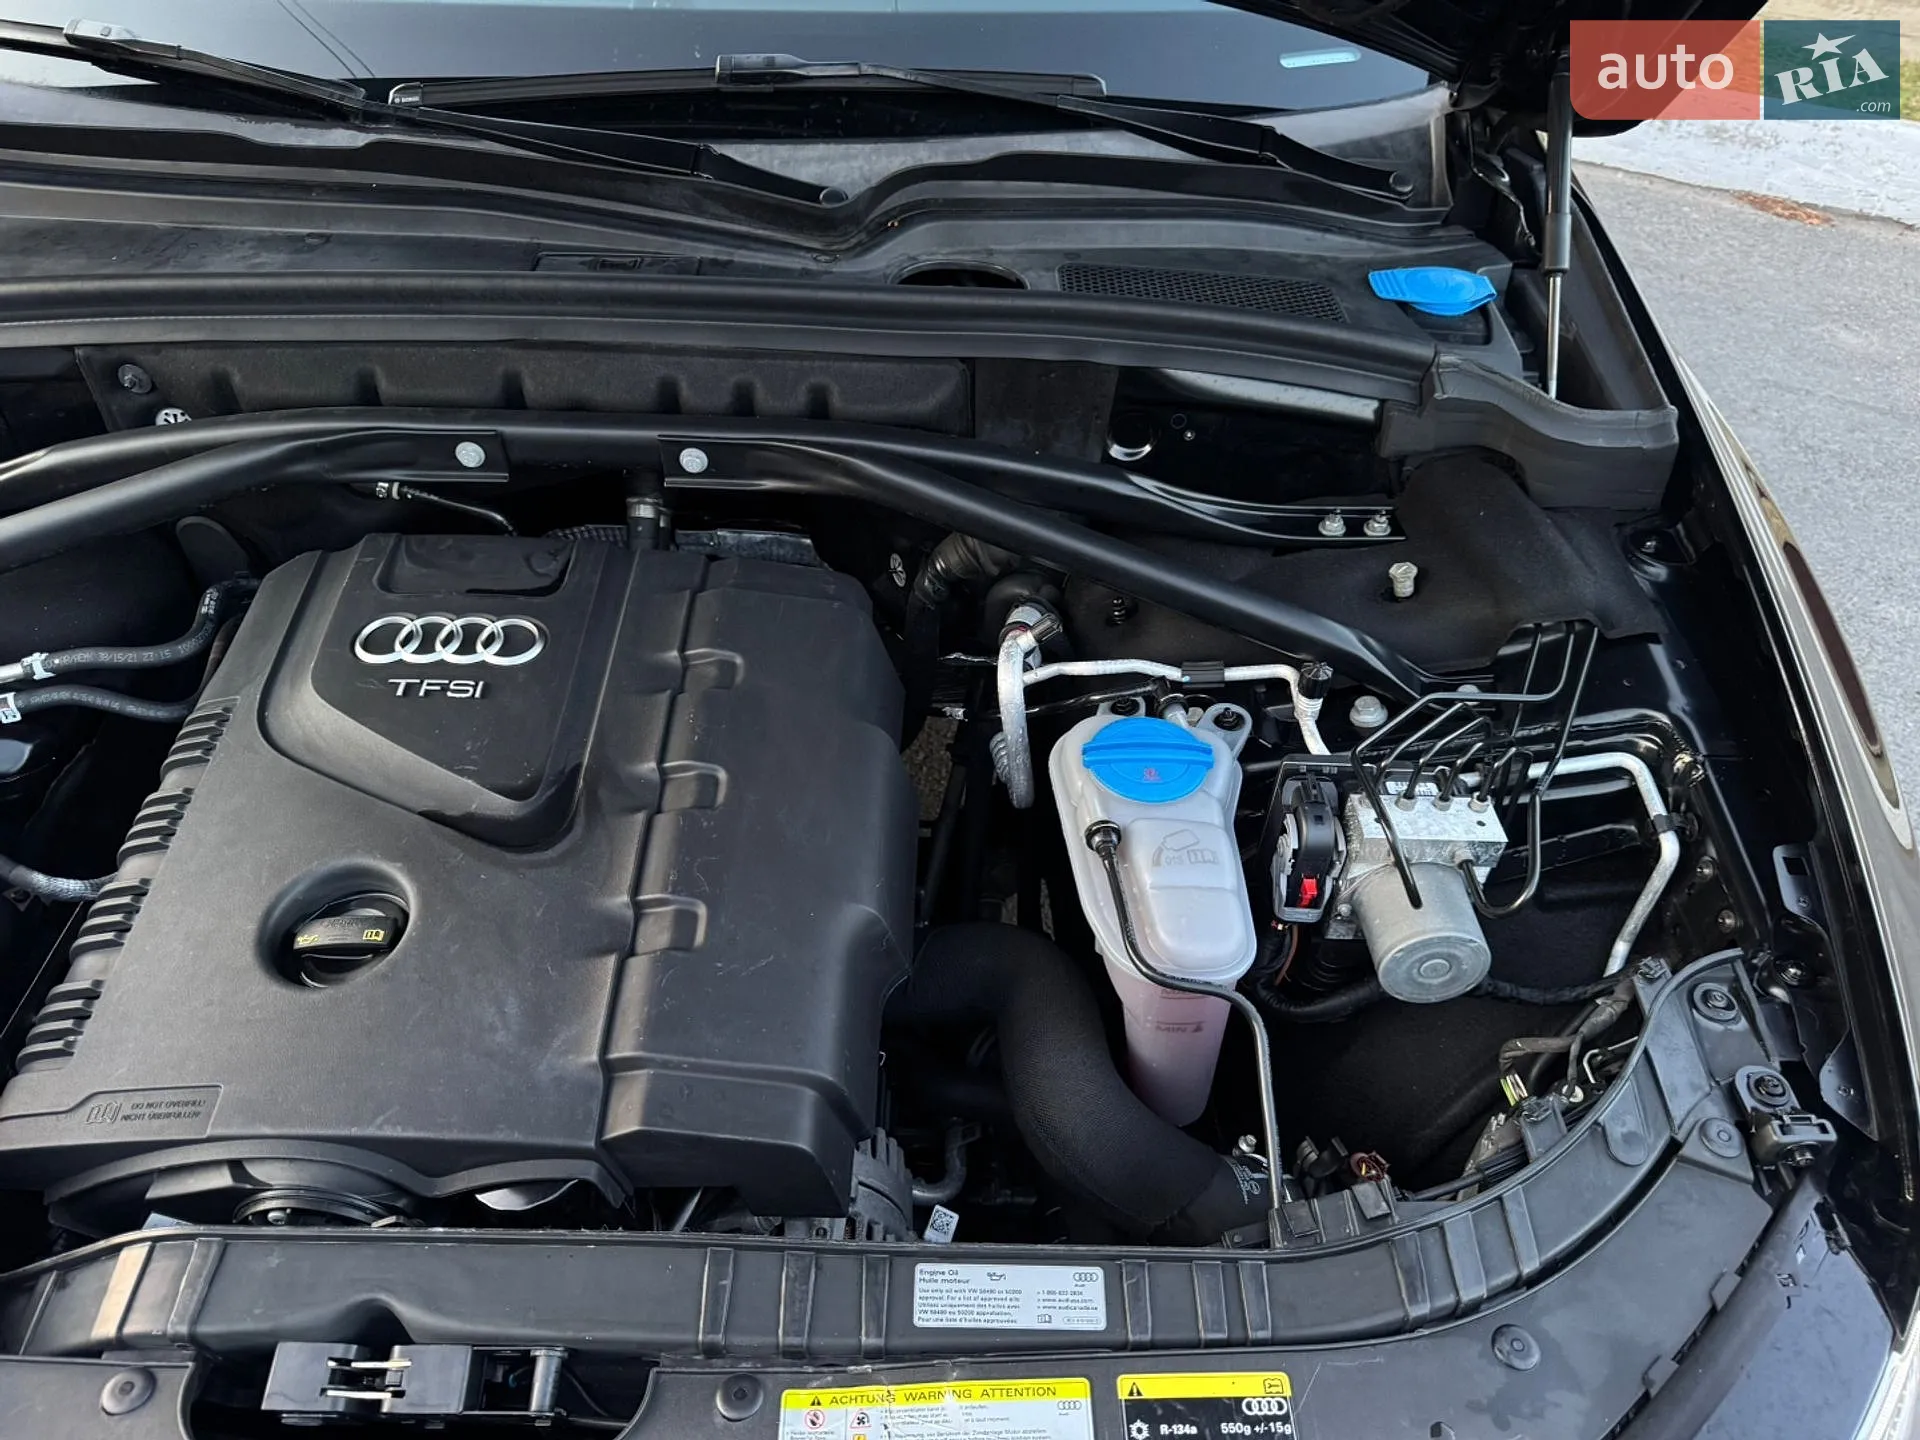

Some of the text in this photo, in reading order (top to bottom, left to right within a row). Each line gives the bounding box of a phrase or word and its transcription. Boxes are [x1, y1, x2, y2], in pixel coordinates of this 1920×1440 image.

[388, 679, 484, 698] TFSI
[131, 1102, 144, 1110] DO
[145, 1101, 163, 1109] NOT
[919, 1269, 946, 1277] Engine
[829, 1392, 896, 1407] ACHTUNG
[980, 1386, 1057, 1398] ATTENTION
[1159, 1424, 1198, 1435] R-134a
[1220, 1422, 1252, 1436] 550g
